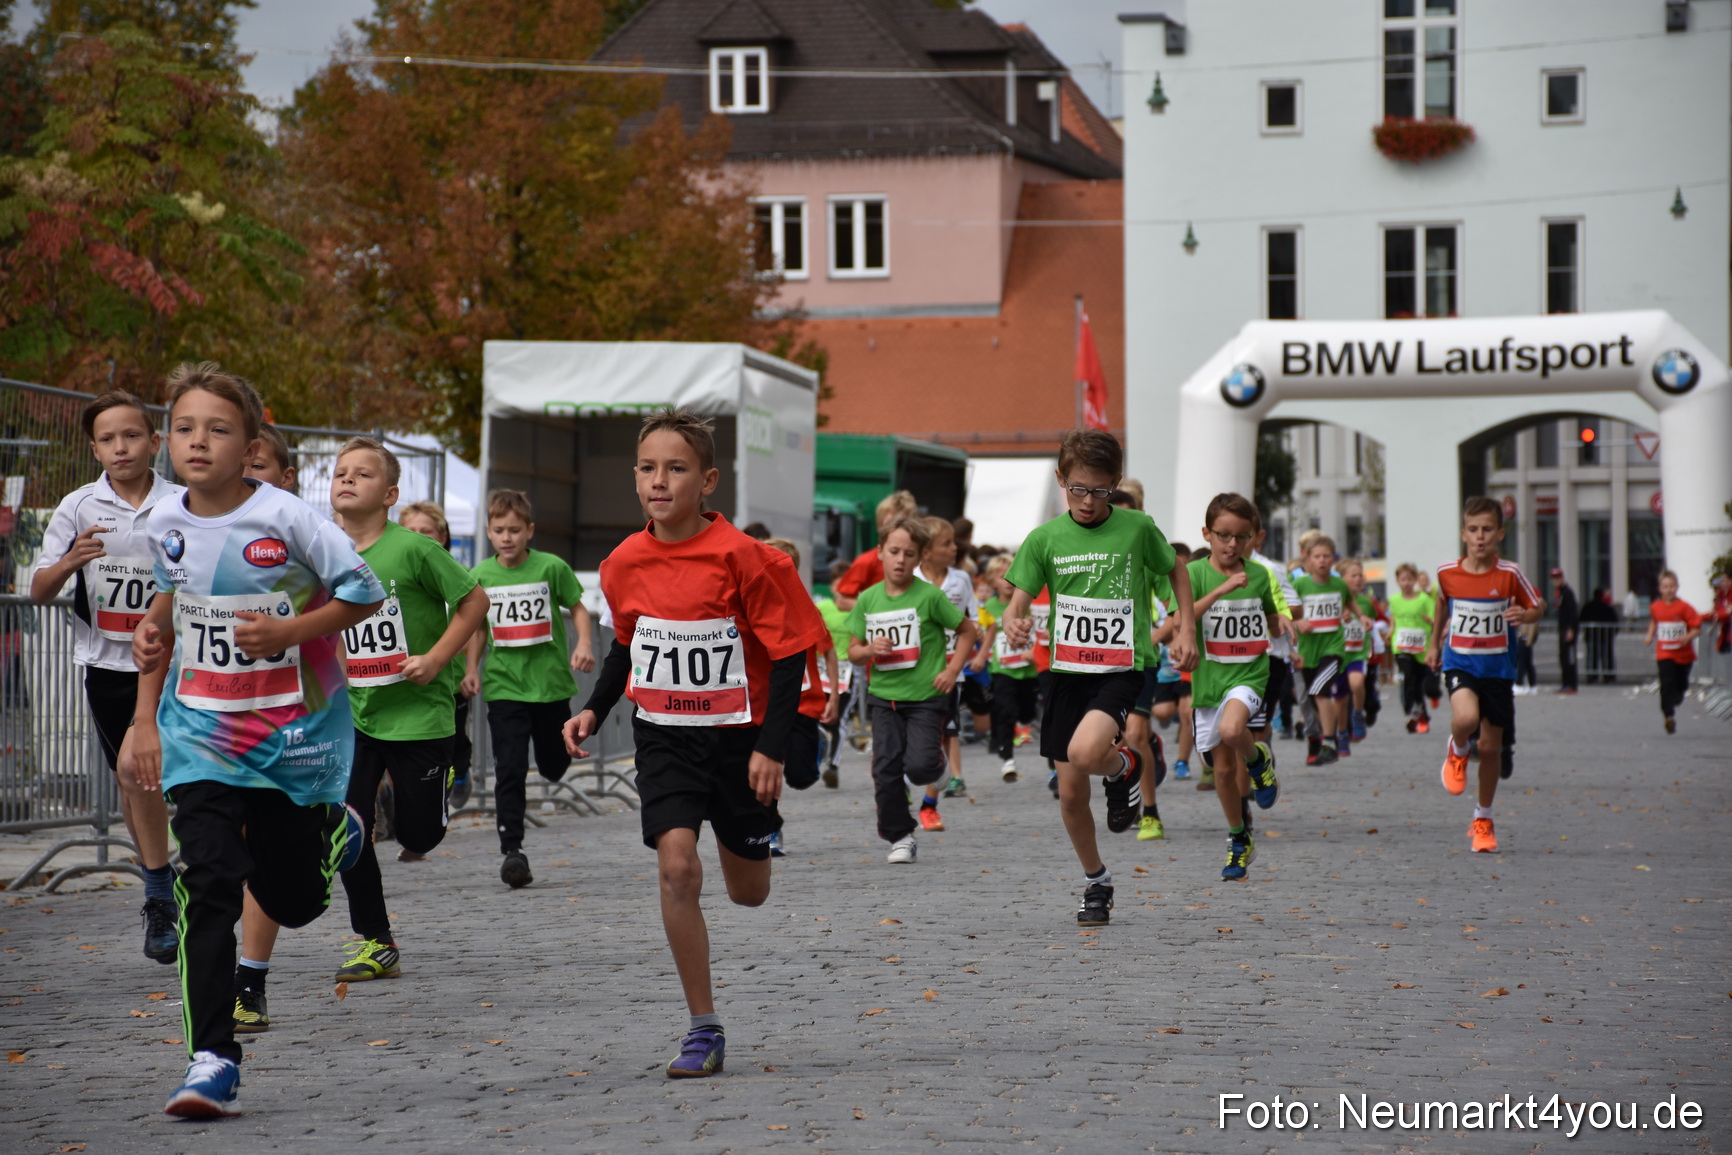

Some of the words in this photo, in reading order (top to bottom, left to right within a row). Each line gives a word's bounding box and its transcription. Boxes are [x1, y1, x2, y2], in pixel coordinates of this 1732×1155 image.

[1282, 341, 1402, 376] BMW
[1416, 335, 1634, 378] Laufsport
[250, 546, 287, 560] Hervis
[1053, 552, 1109, 565] Neumarkter
[98, 564, 130, 574] PARTL
[1056, 563, 1097, 575] Stadtlauf
[106, 577, 158, 610] 702
[508, 590, 539, 598] Neumarkt
[180, 604, 209, 618] PARTL
[211, 606, 272, 619] Neuarkt
[491, 598, 546, 623] 7432
[1057, 602, 1079, 612] PARTL
[1081, 606, 1119, 614] Neumarkt
[1308, 602, 1341, 618] 7405
[1062, 614, 1126, 645] 7052
[1210, 615, 1264, 638] 7083
[1458, 614, 1503, 635] 7210
[345, 620, 397, 655] 049
[635, 626, 666, 640] PARTL
[668, 630, 723, 642] Neumarkt
[1078, 650, 1104, 662] Felix
[1229, 645, 1247, 654] Tim
[641, 644, 734, 686] 7107
[664, 695, 711, 711] Jamie
[282, 727, 307, 746] 16.
[282, 741, 333, 758] Neumarkter
